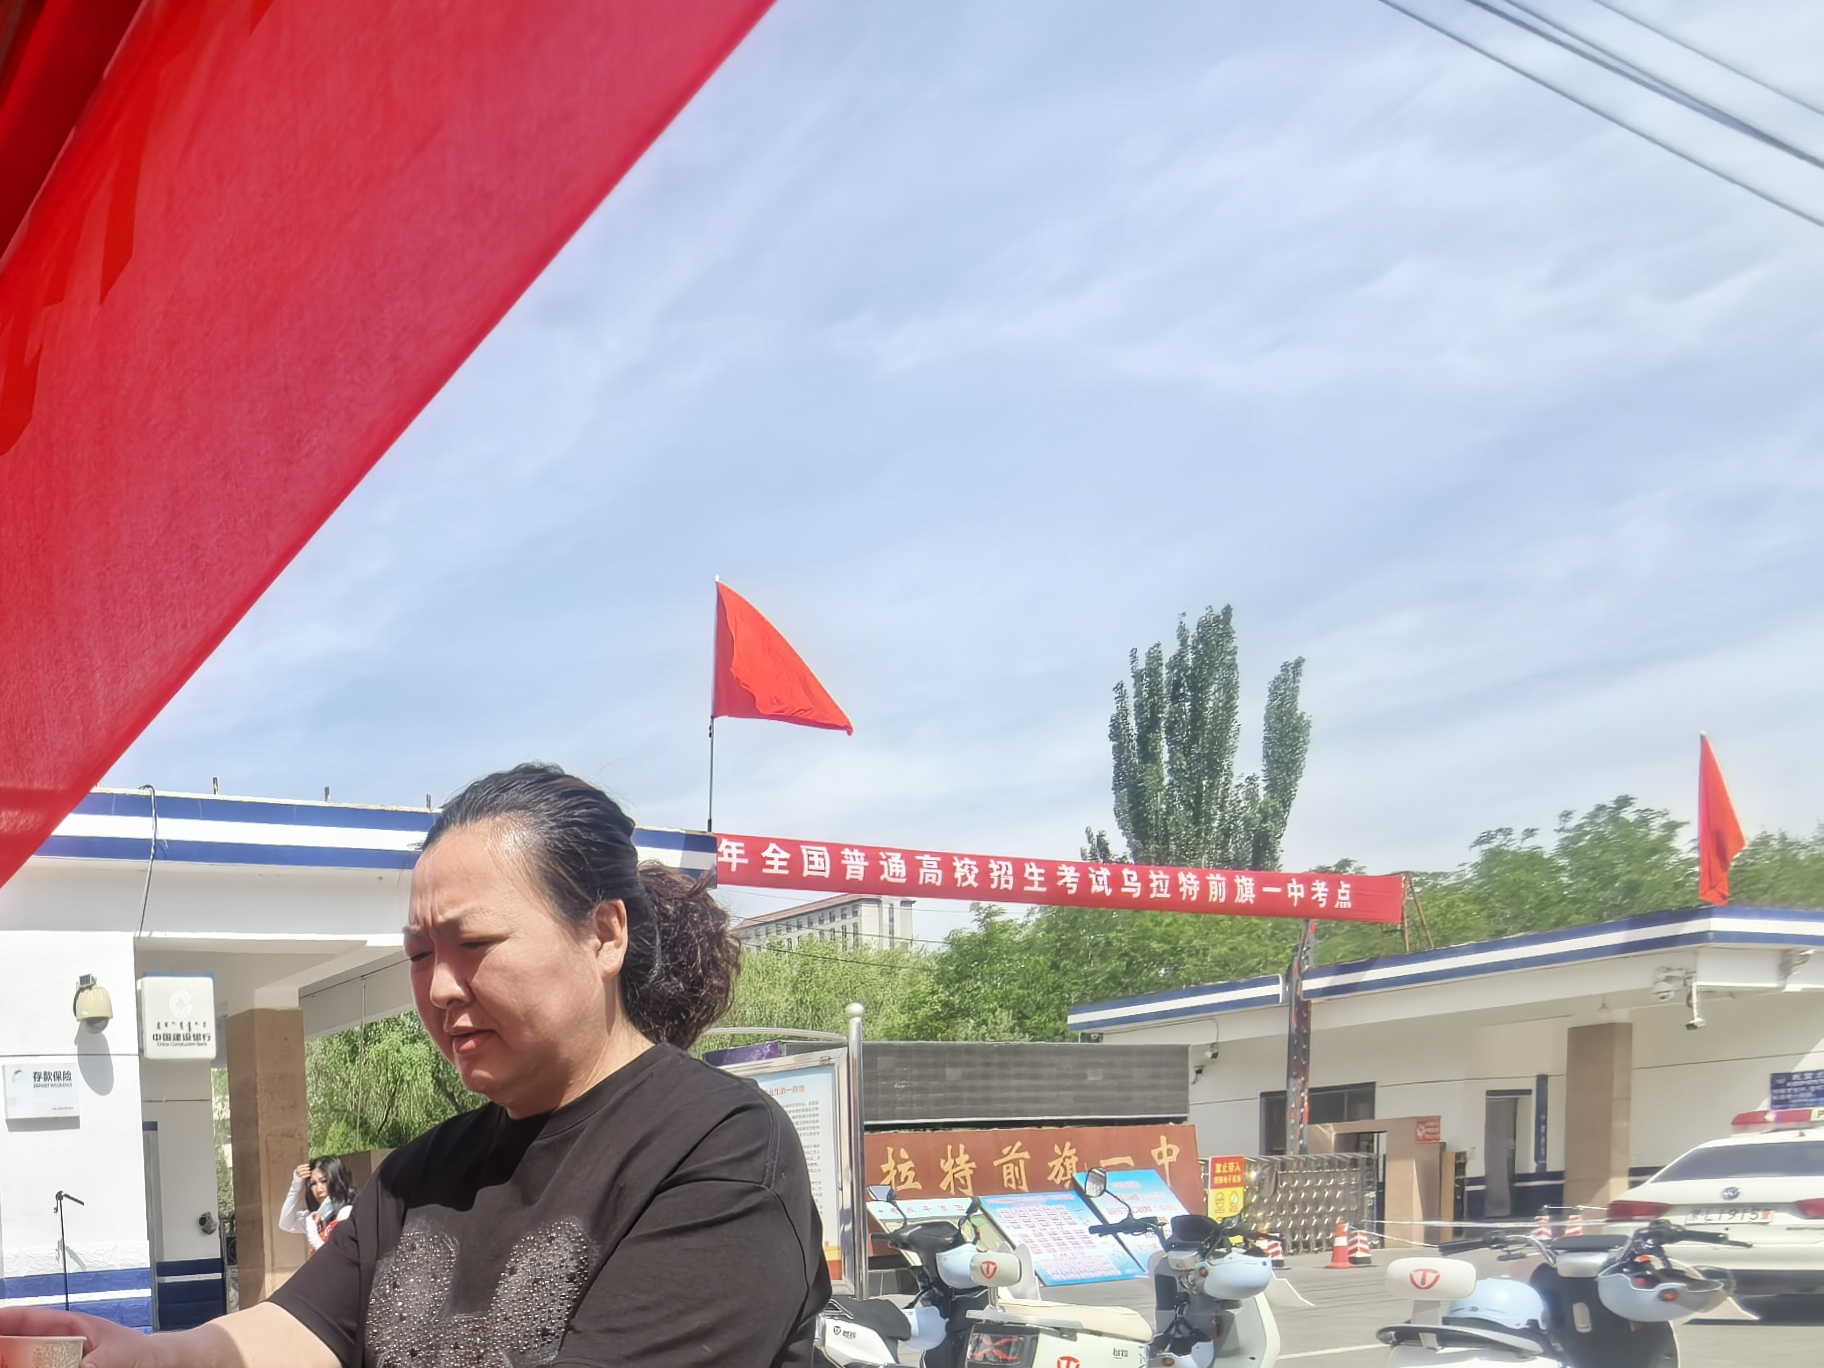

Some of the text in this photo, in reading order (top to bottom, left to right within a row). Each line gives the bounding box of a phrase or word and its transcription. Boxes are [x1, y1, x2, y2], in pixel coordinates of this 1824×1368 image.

[717, 838, 1352, 909] 年全国普通高校招生考试乌拉特前旗一中考点
[152, 1033, 211, 1041] 中国建设银行
[33, 1070, 72, 1082] 存款保险
